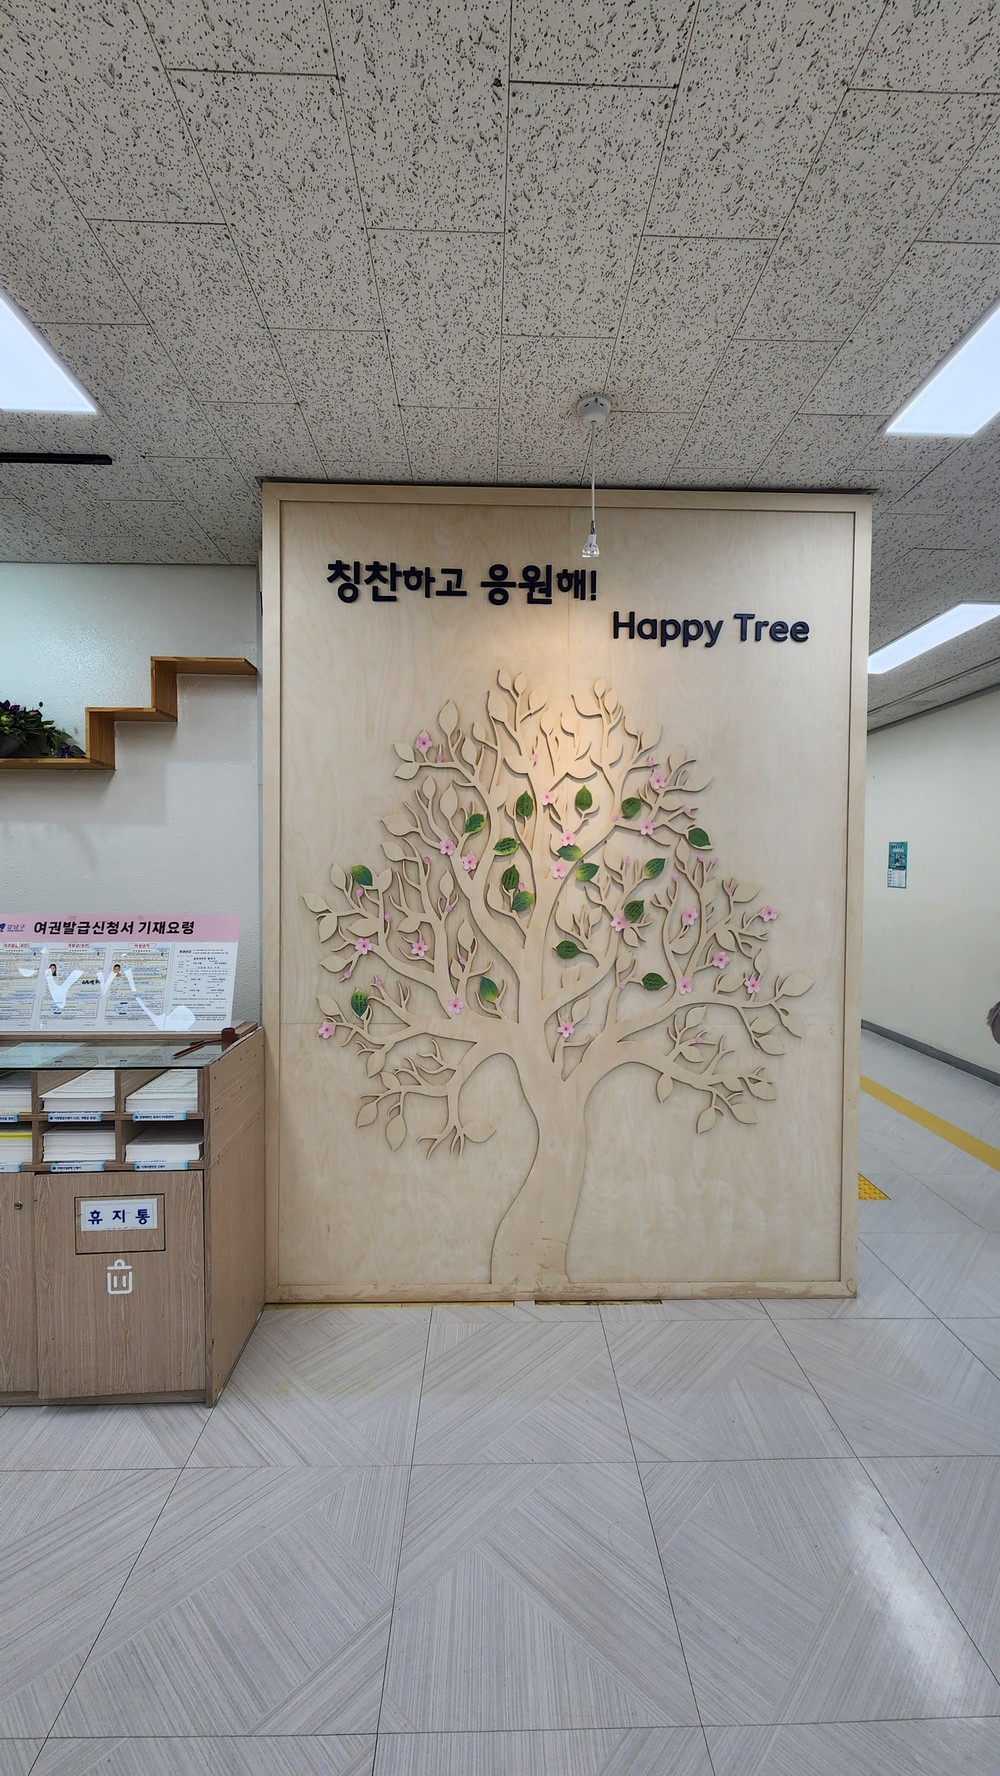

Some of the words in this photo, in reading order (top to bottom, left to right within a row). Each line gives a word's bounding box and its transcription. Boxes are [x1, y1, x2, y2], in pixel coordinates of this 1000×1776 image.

[327, 560, 467, 603] 칭찬하고
[480, 563, 597, 605] 응원해!
[613, 611, 724, 647] Happy
[734, 613, 810, 642] Tree
[33, 921, 134, 935] 여권발급신청서
[138, 921, 195, 935] 기재요령
